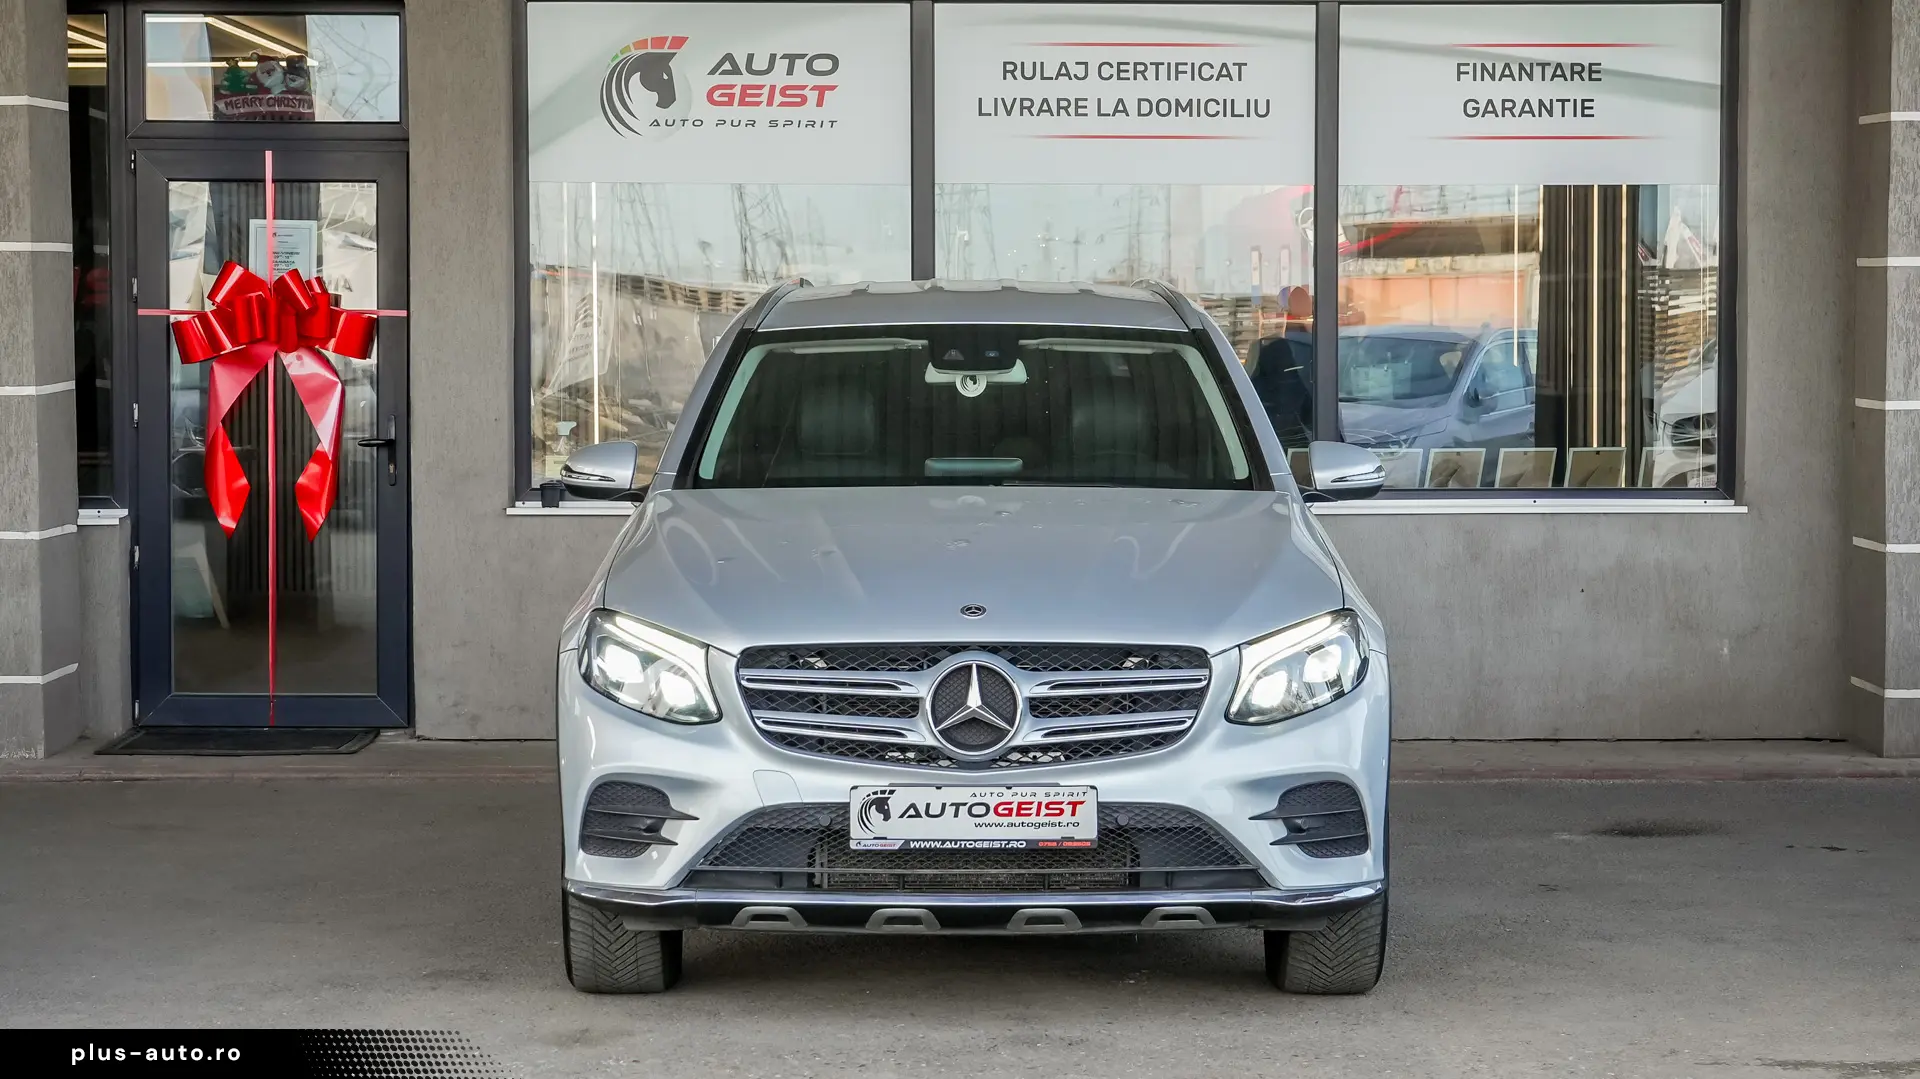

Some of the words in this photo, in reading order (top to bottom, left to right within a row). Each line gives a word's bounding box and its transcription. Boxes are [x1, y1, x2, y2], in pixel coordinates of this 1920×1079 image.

[706, 52, 840, 76] AUTO
[1001, 60, 1090, 81] RULAJ
[1097, 61, 1248, 82] CERTIFICAT
[1456, 62, 1602, 82] FINANTARE
[223, 97, 263, 111] MERRY
[706, 84, 839, 108] GEIST
[977, 97, 1089, 117] LIVRARE
[1096, 98, 1130, 118] LA
[1136, 98, 1271, 119] DOMICILIU
[1463, 98, 1595, 118] GARANTIE
[648, 118, 704, 128] AUTO
[715, 119, 757, 128] PUR
[768, 119, 839, 129] SPIRIT
[898, 801, 1086, 819] AUTOGEIST
[974, 820, 1080, 829] www.autogeist.ro
[909, 841, 1026, 849] WWW.AUTOGEIST.RO
